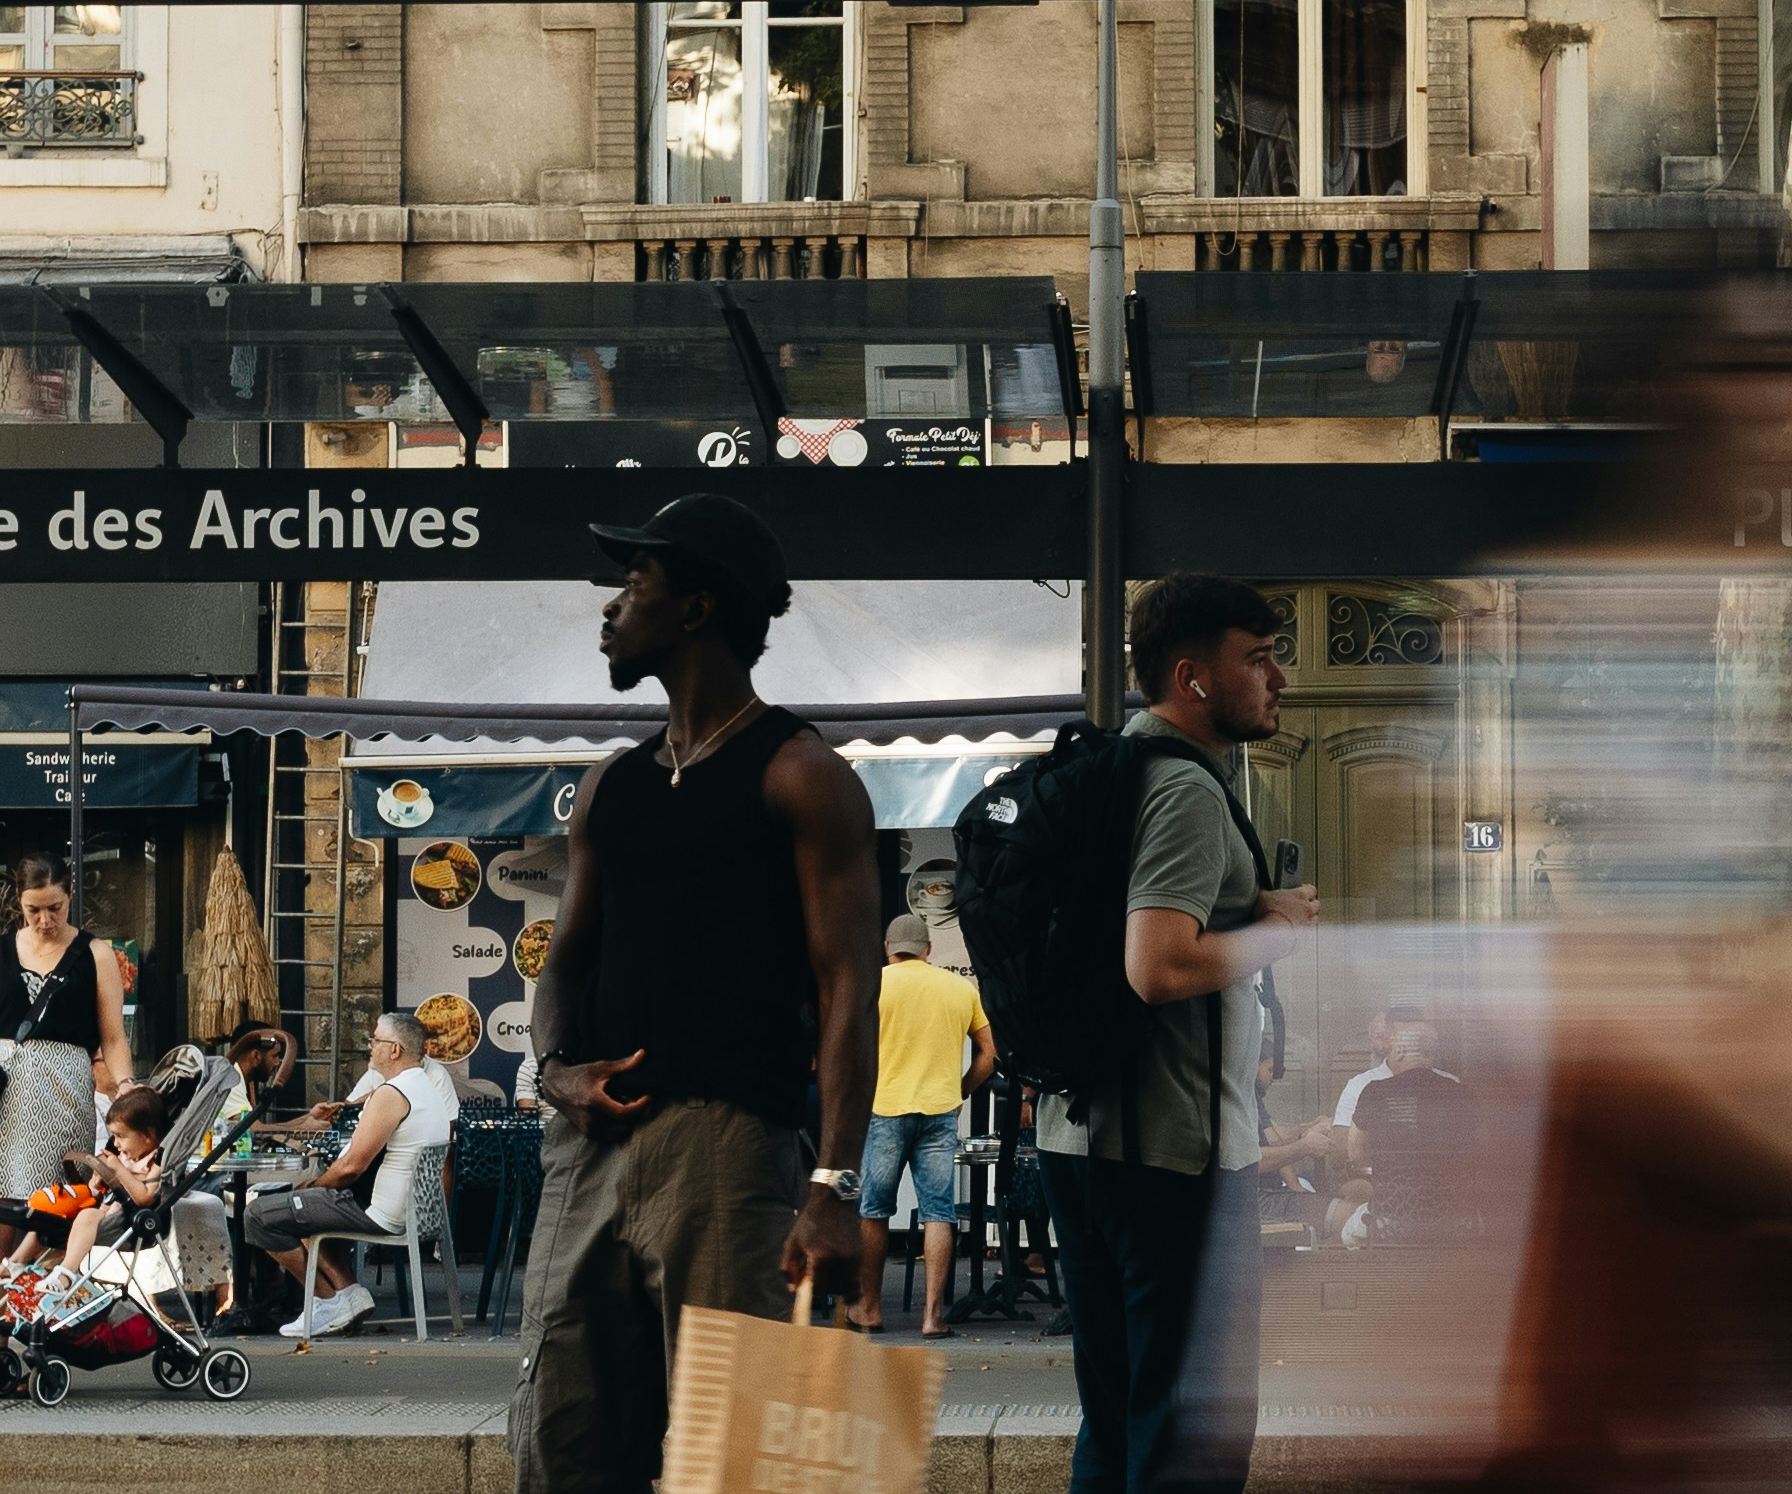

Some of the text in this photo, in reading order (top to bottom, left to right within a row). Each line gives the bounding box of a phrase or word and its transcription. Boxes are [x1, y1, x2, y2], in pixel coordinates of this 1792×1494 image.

[48, 490, 163, 551] des
[190, 489, 480, 550] Archives
[26, 752, 116, 765] Sandwherie
[44, 770, 97, 783] Traiur
[1472, 826, 1494, 847] 16
[498, 866, 549, 881] Panini
[452, 944, 503, 958] Salade
